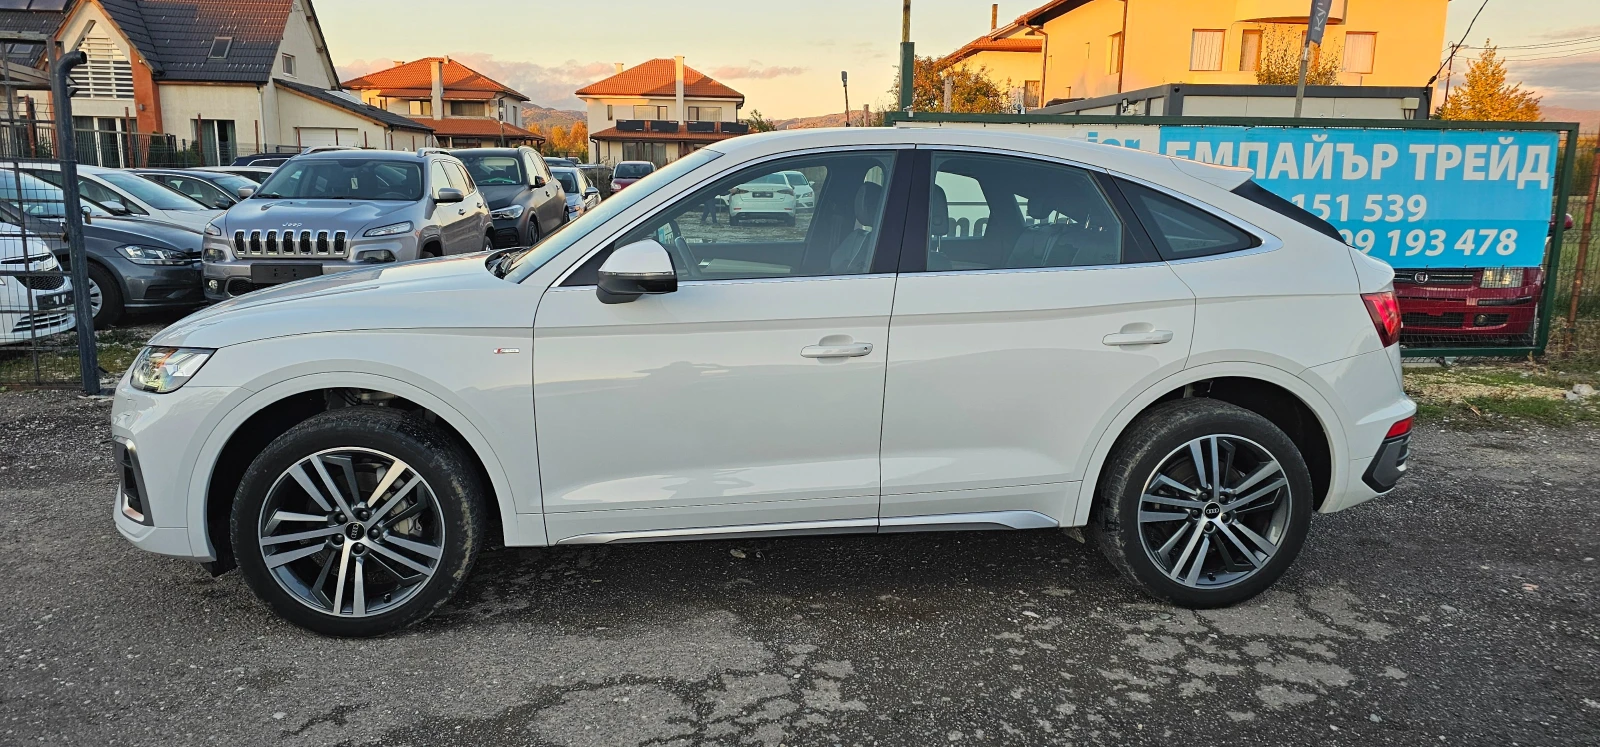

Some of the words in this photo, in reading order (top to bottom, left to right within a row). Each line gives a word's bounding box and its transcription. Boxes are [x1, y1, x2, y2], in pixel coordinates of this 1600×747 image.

[1408, 136, 1551, 190] ТРЕЙД
[1363, 194, 1427, 223] 539
[1387, 228, 1447, 257] 193
[1453, 228, 1518, 256] 478
